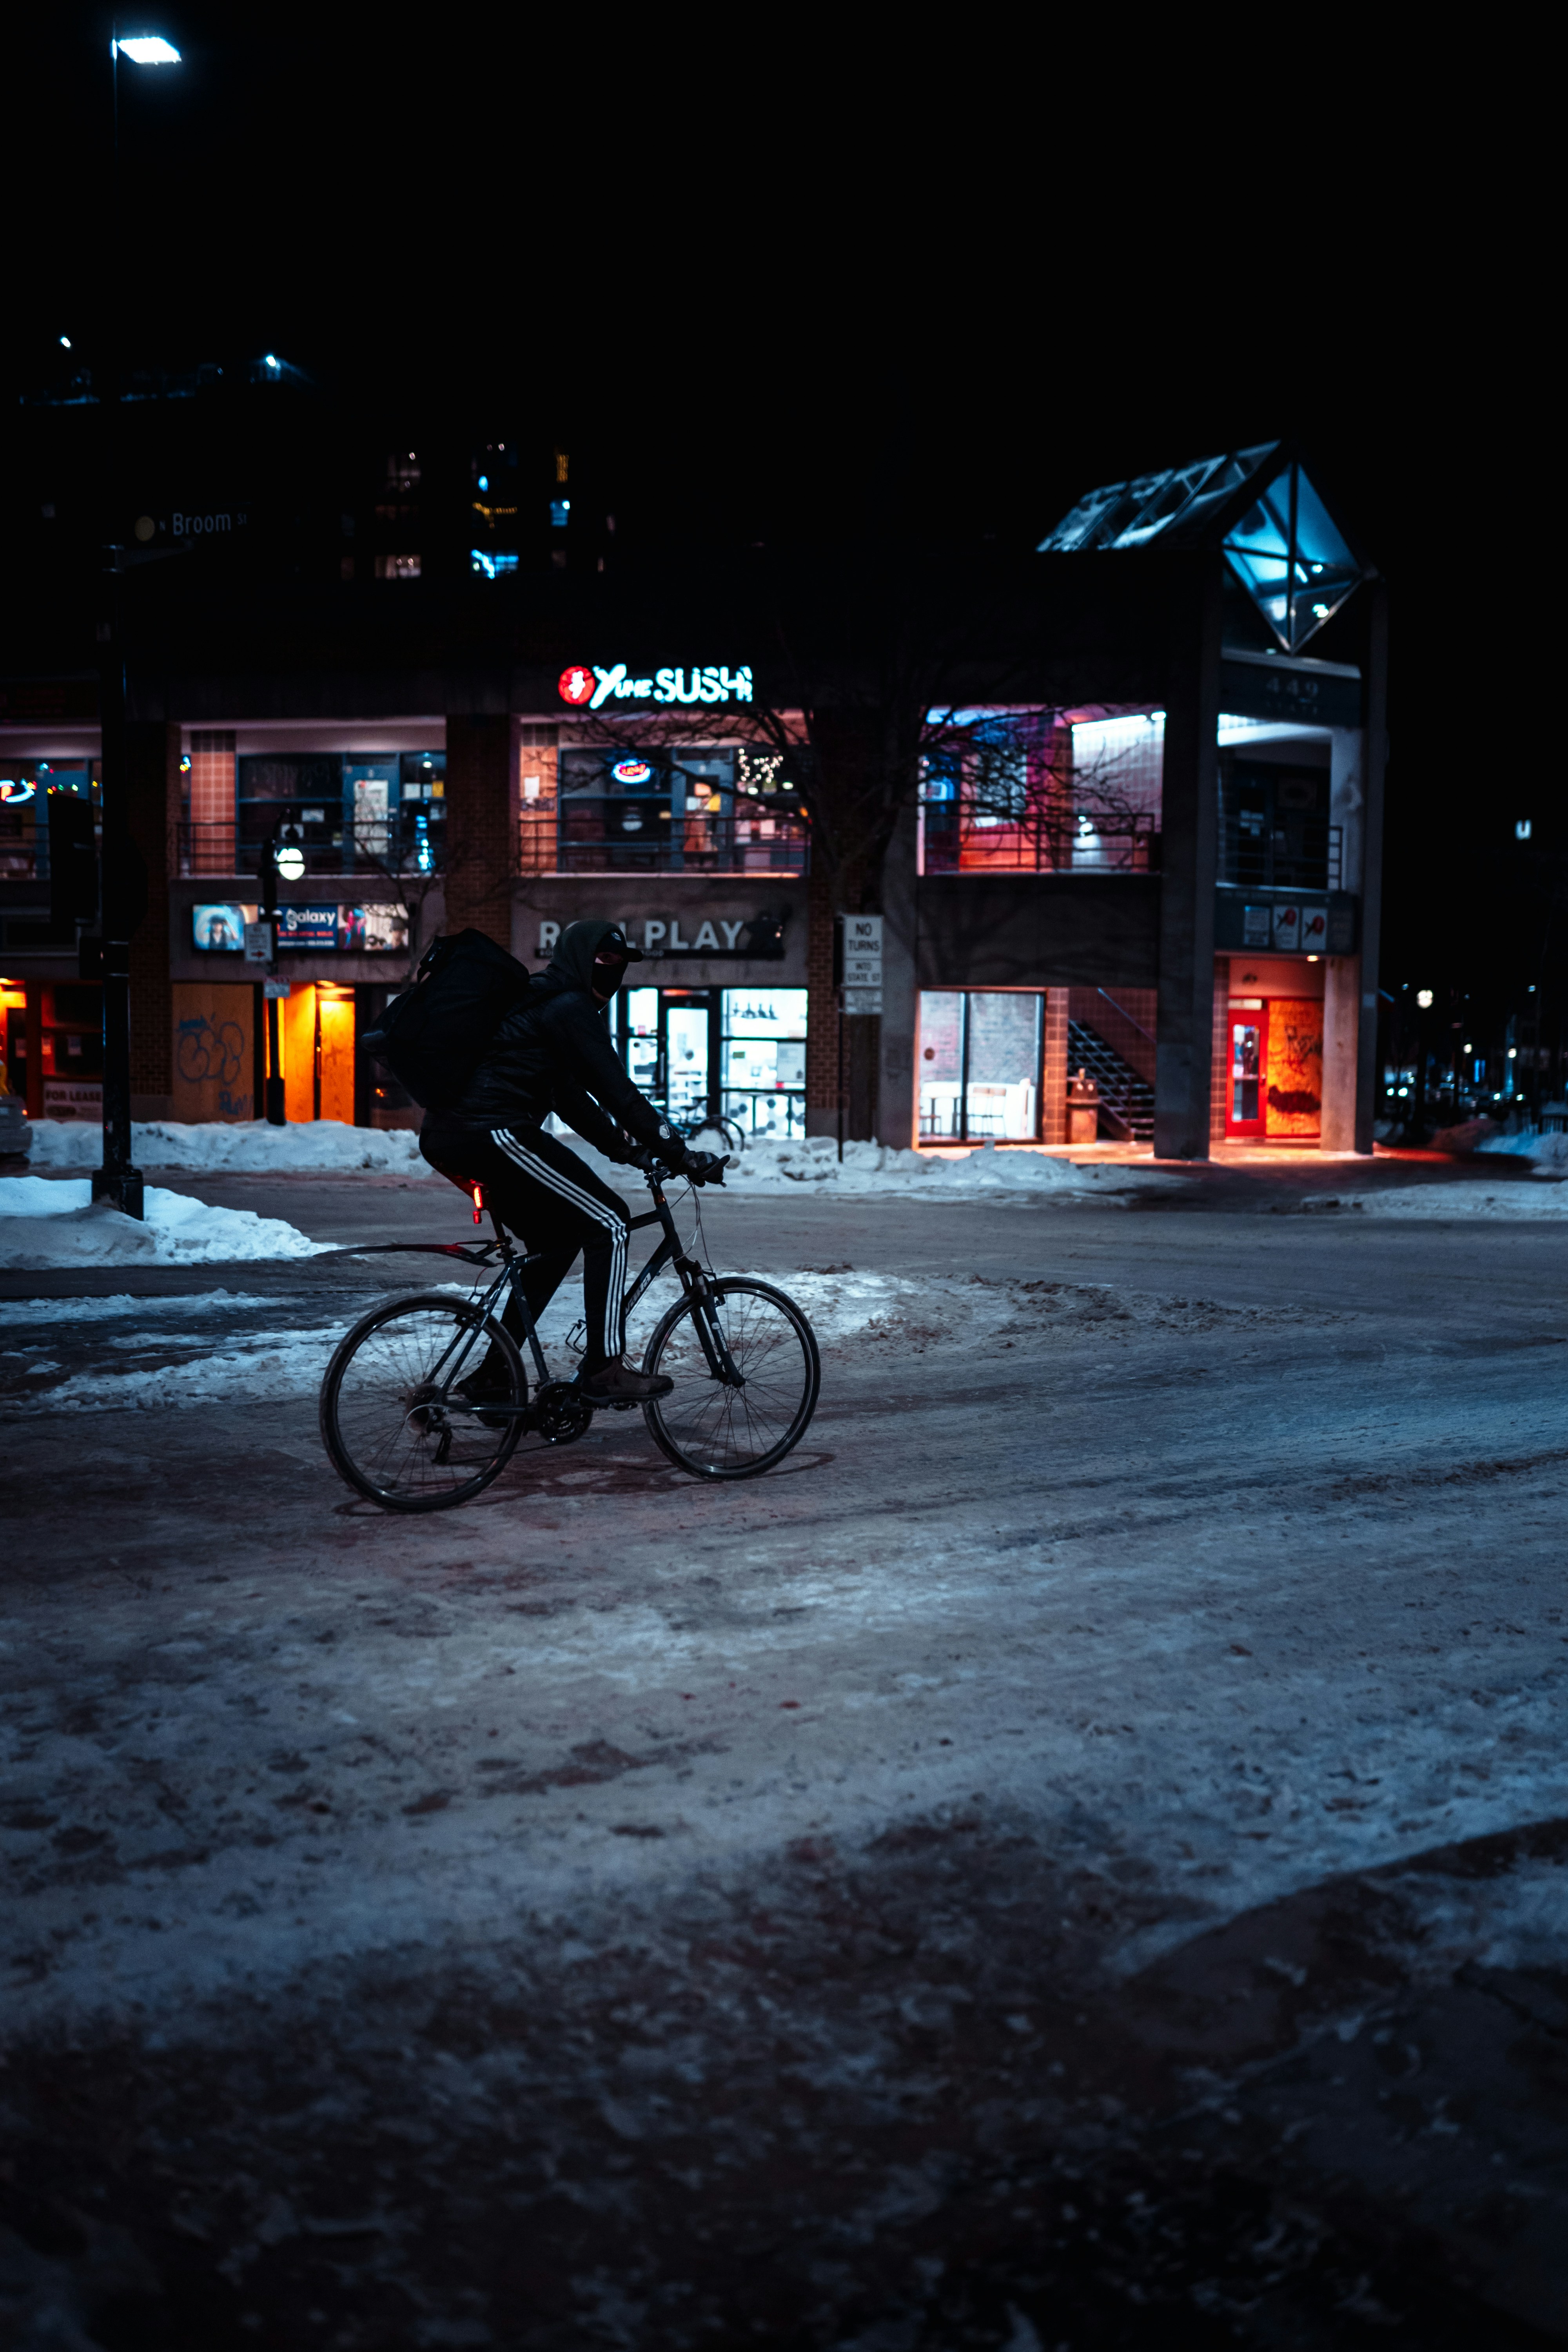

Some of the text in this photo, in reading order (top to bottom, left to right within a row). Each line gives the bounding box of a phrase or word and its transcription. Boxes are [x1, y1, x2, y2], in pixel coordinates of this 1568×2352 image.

[159, 519, 166, 532] N
[172, 512, 231, 536] Broom
[1266, 677, 1319, 698] 449
[539, 921, 744, 950] RL PLAY
[856, 923, 872, 936] NO
[849, 940, 880, 952] TURNS
[45, 1091, 101, 1106] FOR LEASE
